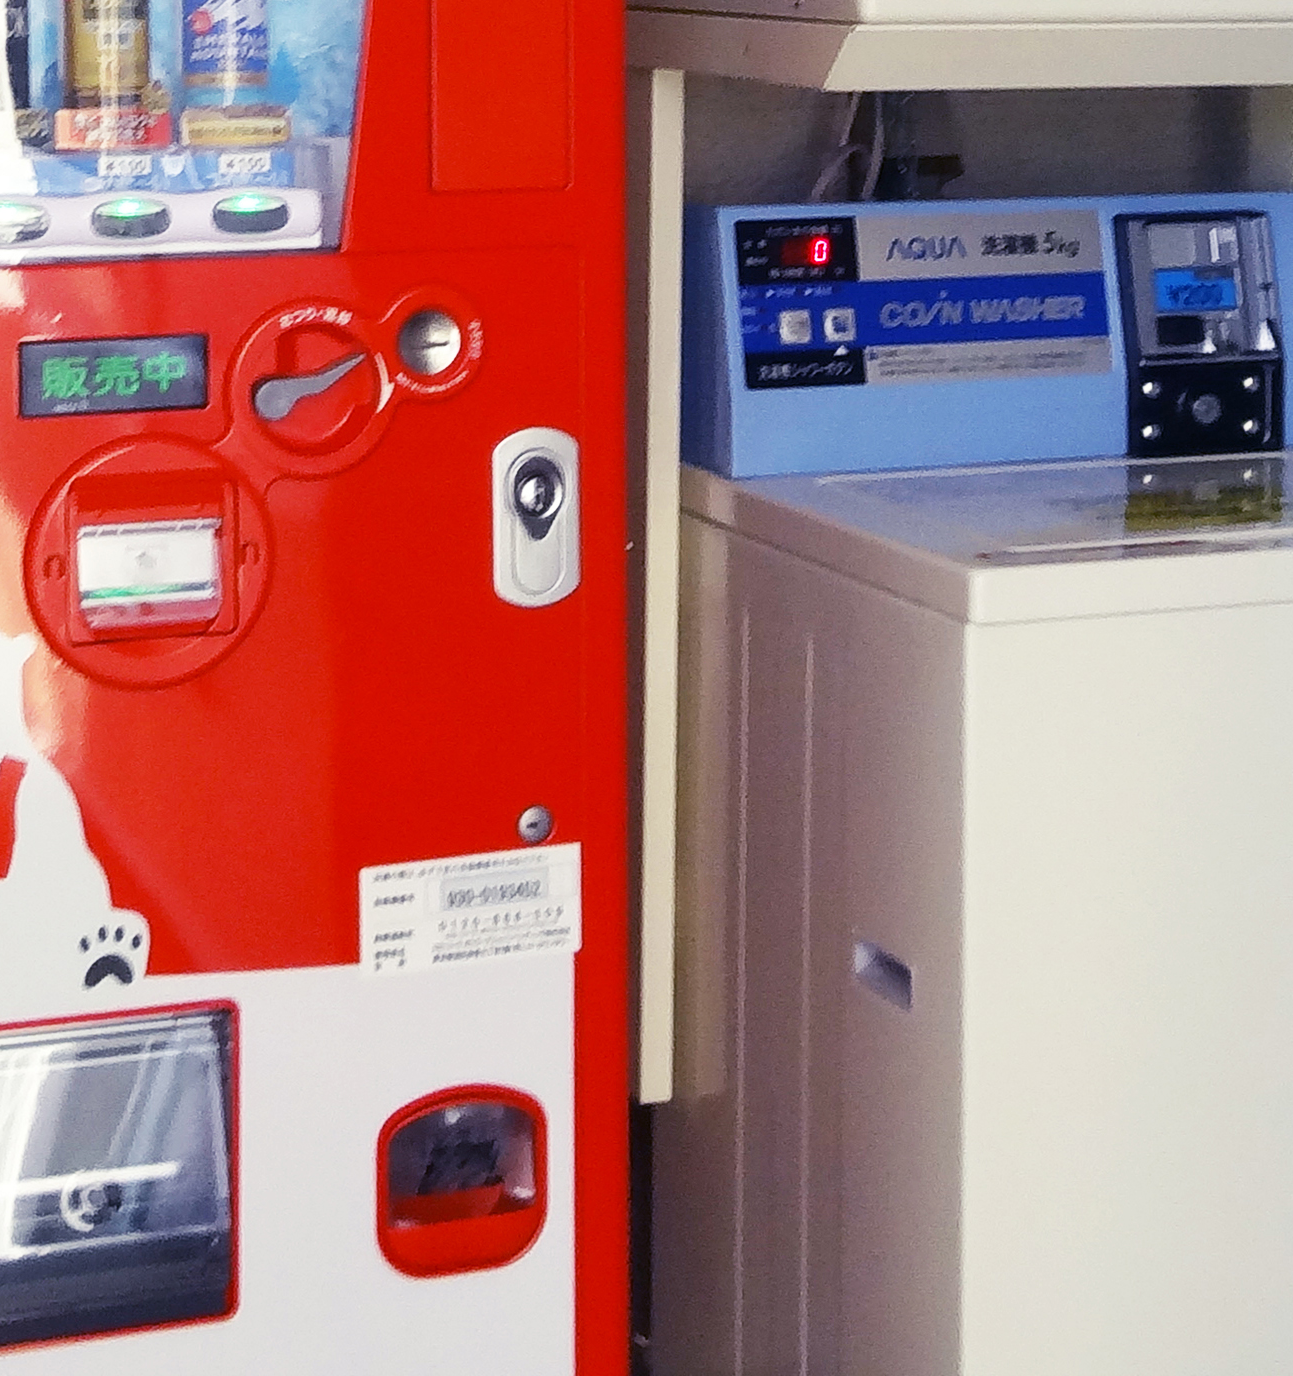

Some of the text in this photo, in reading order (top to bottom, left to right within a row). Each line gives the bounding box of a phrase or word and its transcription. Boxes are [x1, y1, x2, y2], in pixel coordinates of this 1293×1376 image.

[813, 239, 828, 263] 0
[885, 235, 968, 262] AQUA
[969, 294, 1088, 324] WASHER
[39, 351, 188, 401] 販売中
